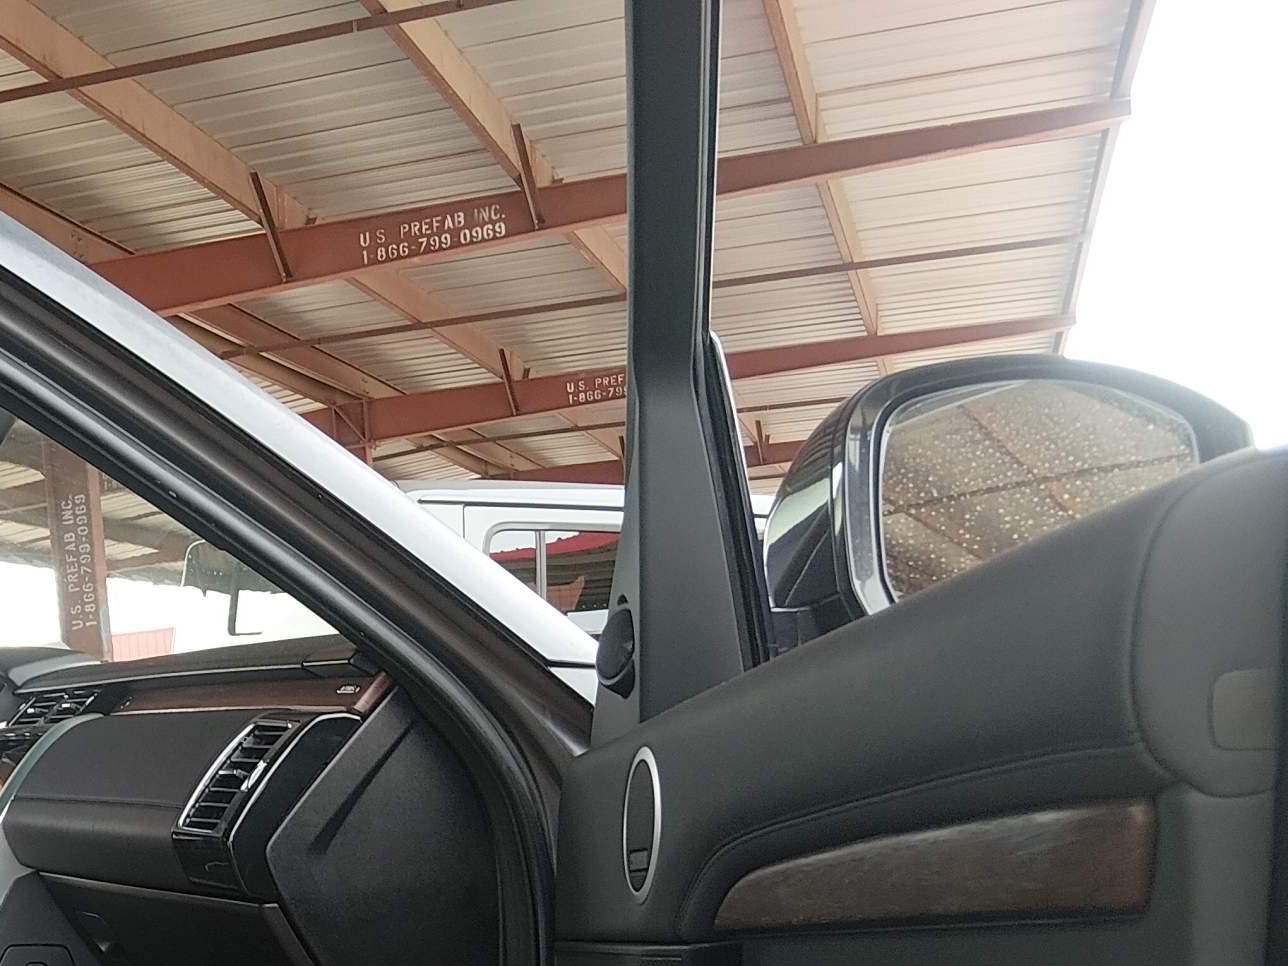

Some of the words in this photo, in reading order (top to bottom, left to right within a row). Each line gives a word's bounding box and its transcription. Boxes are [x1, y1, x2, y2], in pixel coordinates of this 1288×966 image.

[400, 211, 465, 239] PREFAB
[473, 204, 506, 223] INC.
[63, 531, 81, 593] PREFAB
[74, 493, 98, 627] 1-866-799-0969
